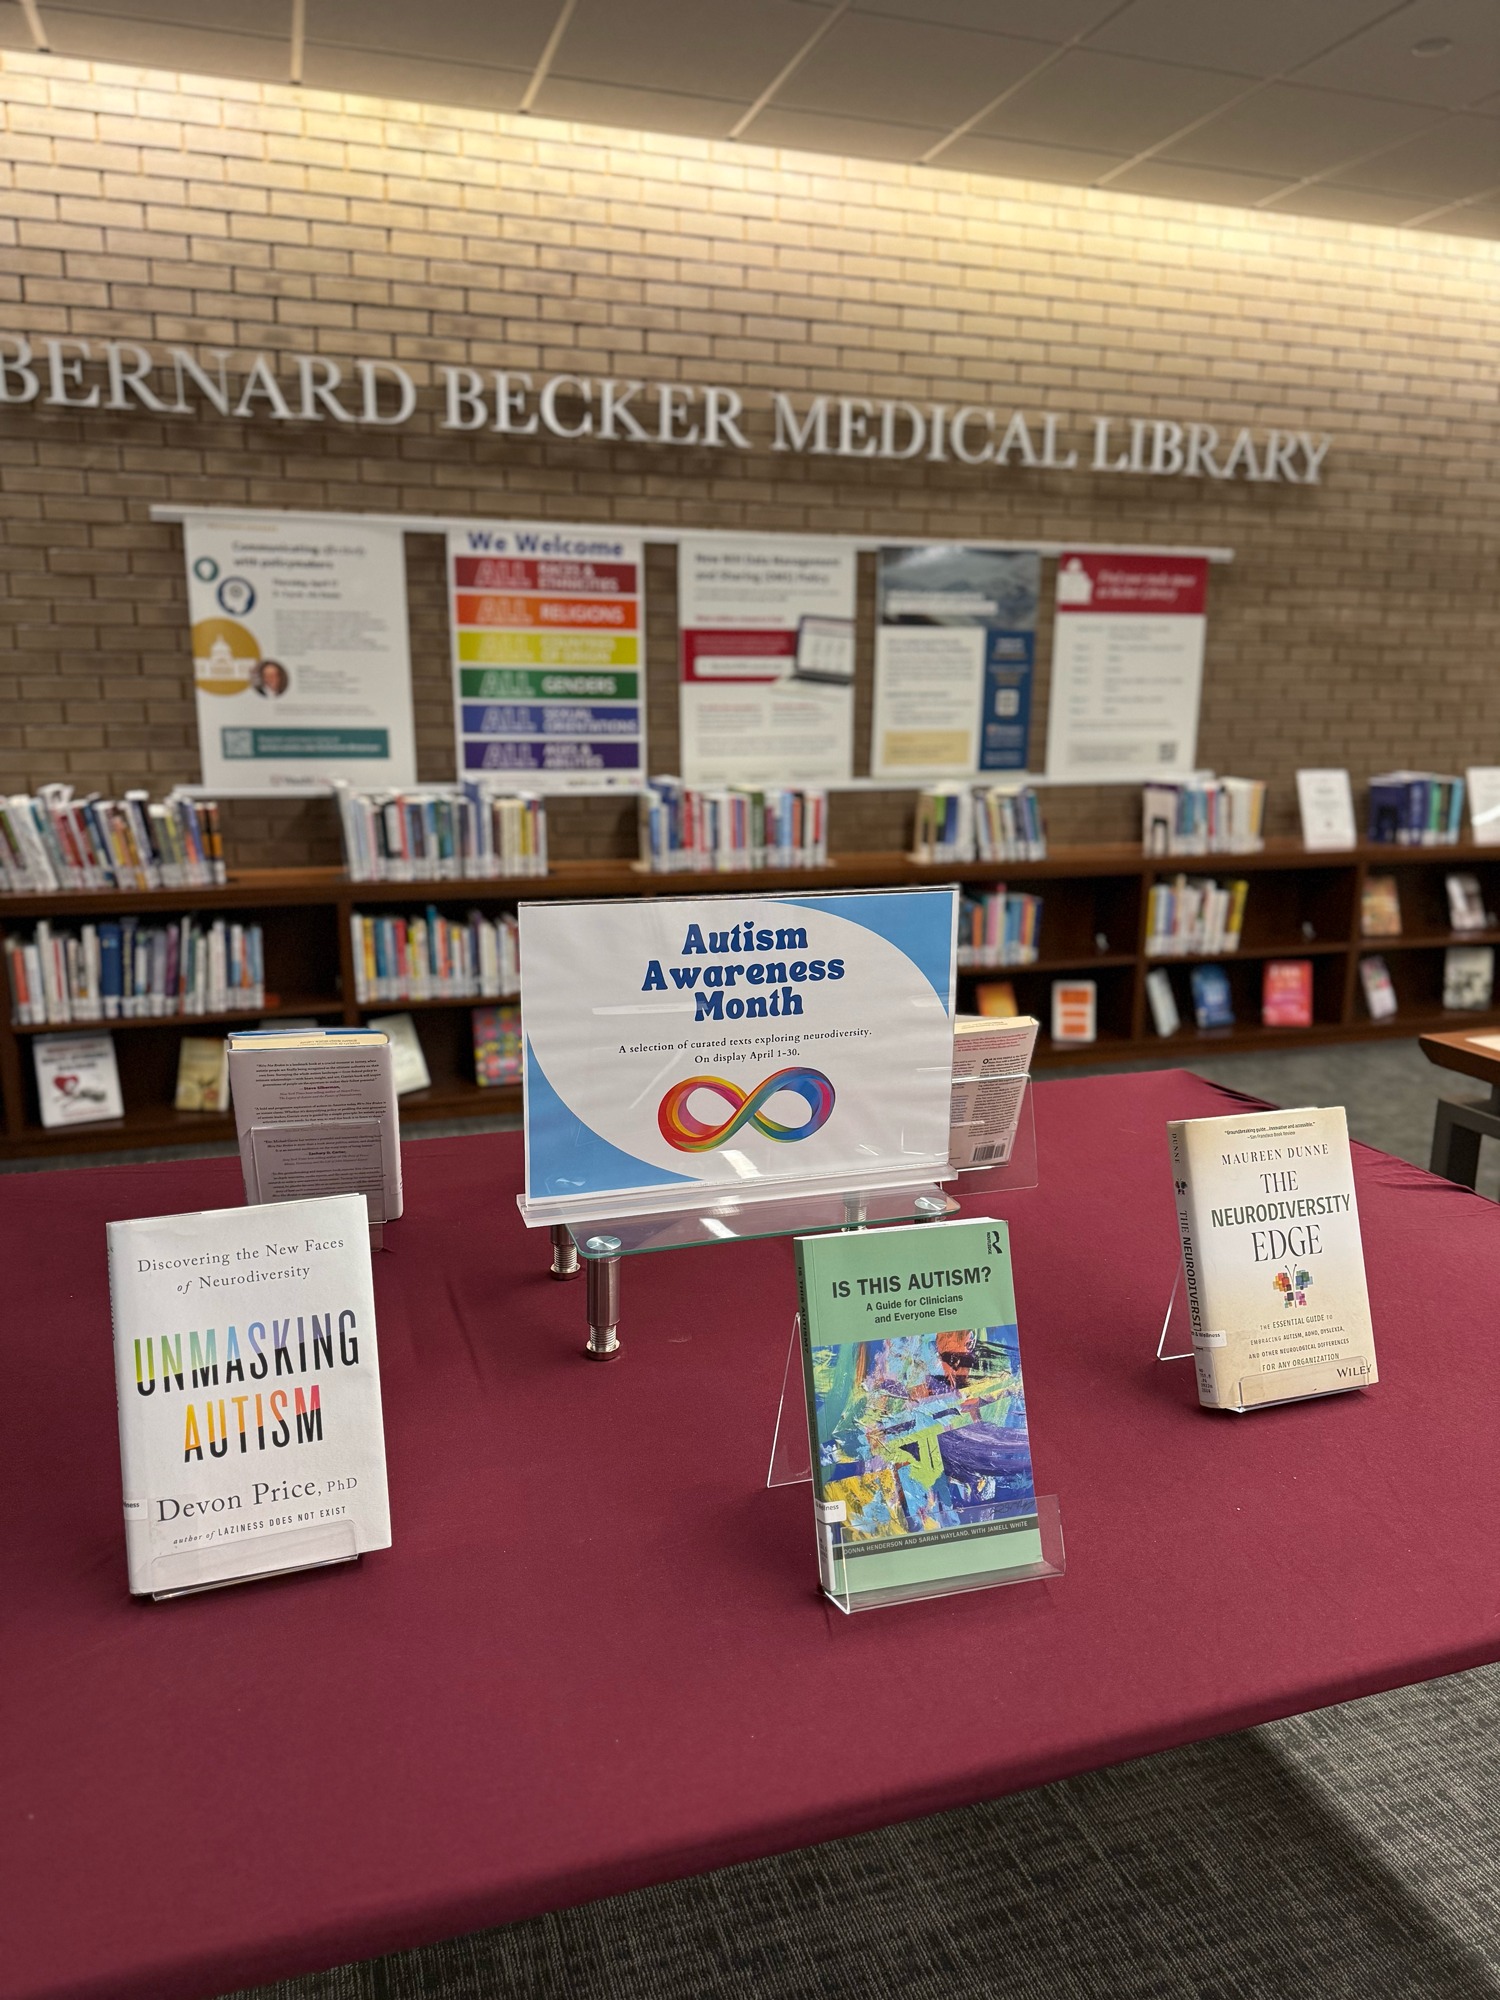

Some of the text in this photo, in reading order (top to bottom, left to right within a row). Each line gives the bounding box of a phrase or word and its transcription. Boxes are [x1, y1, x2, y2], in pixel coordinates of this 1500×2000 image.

[0, 332, 1334, 484] BERNARD BECKER MEDICAL LIBRARY
[467, 530, 624, 557] We Welcome
[539, 602, 626, 625] RELIGIONS
[541, 675, 618, 696] GENDERS
[681, 921, 809, 955] Autism
[641, 958, 845, 991] Awareness
[694, 986, 804, 1021] Month
[618, 1028, 872, 1053] A selection of curated texts exploring neurodiversity.
[694, 1054, 710, 1064] On
[713, 1051, 747, 1064] display
[750, 1049, 774, 1062] April
[1221, 1143, 1330, 1165] MAUREEN DUNNE
[1260, 1170, 1299, 1194] THE
[1211, 1193, 1350, 1228] NEURODIVERSITY
[137, 1238, 345, 1273] Discovering the New Faces
[1251, 1224, 1323, 1262] EDGE
[177, 1265, 311, 1294] of Neurodiversity
[832, 1266, 992, 1299] IS THIS AUTISM?
[1180, 1210, 1202, 1331] THE NEURODIVERSIT
[866, 1293, 963, 1311] A Guide for Clinicians
[874, 1307, 957, 1324] and Everyone Else
[1272, 1317, 1305, 1329] ESSENTIAL
[1306, 1314, 1325, 1324] GUIDE
[134, 1309, 360, 1397] UNMASKING
[1249, 1338, 1350, 1360] AND OTHER NEUROLOGICAL DIFFERENCES
[1250, 1335, 1282, 1346] EMBRACING
[1283, 1332, 1304, 1342] AUTISM,
[1262, 1353, 1340, 1371] FOR ANY ORGANIZATION
[1337, 1364, 1372, 1379] WILEY
[184, 1384, 323, 1463] AUTISM
[156, 1477, 358, 1523] Devon Price, PhD
[173, 1506, 347, 1545] author of LAZINESS DOES NOT EXIST
[844, 1546, 865, 1555] DONNA
[866, 1540, 904, 1552] HENDERSON
[904, 1537, 918, 1546] AND
[918, 1534, 939, 1544] SARAH
[971, 1526, 986, 1536] WITH
[987, 1523, 1009, 1533] JAMELL
[1010, 1520, 1029, 1530] WHITE
